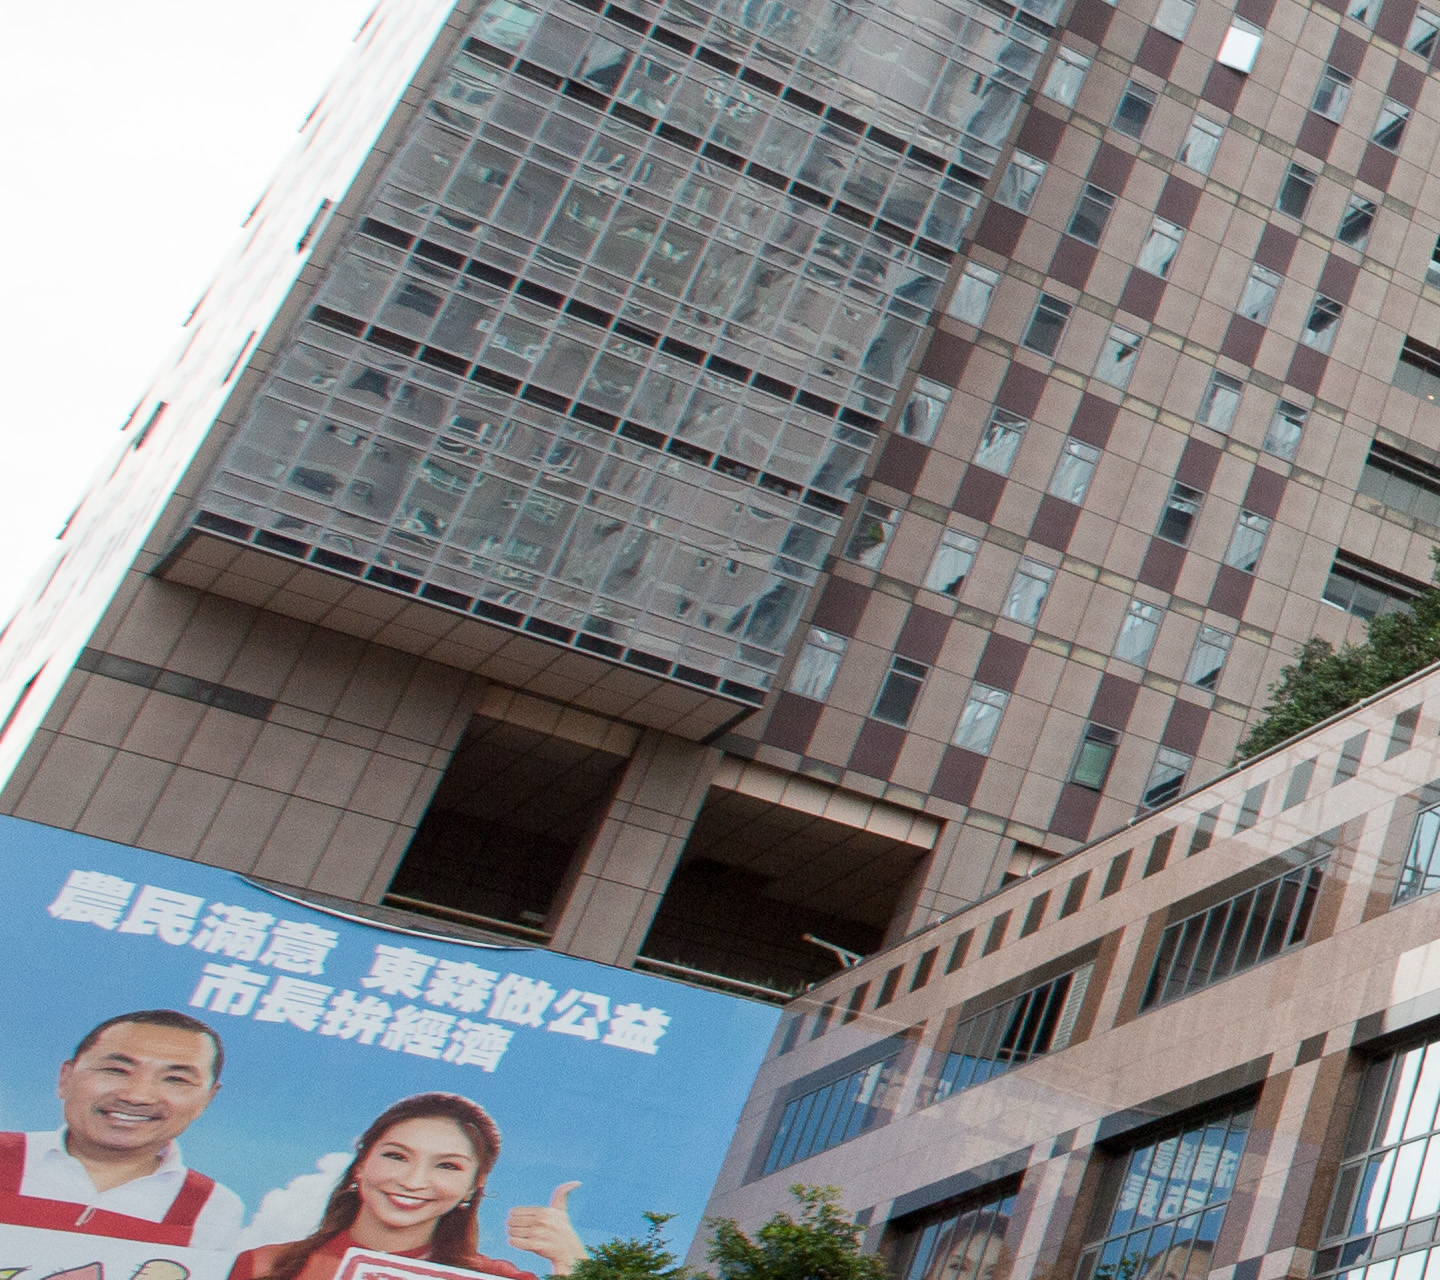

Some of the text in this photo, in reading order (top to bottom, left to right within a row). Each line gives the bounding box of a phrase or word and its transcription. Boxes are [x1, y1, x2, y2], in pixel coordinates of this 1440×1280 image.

[48, 869, 674, 1056] 農民滿意 東森做公益
